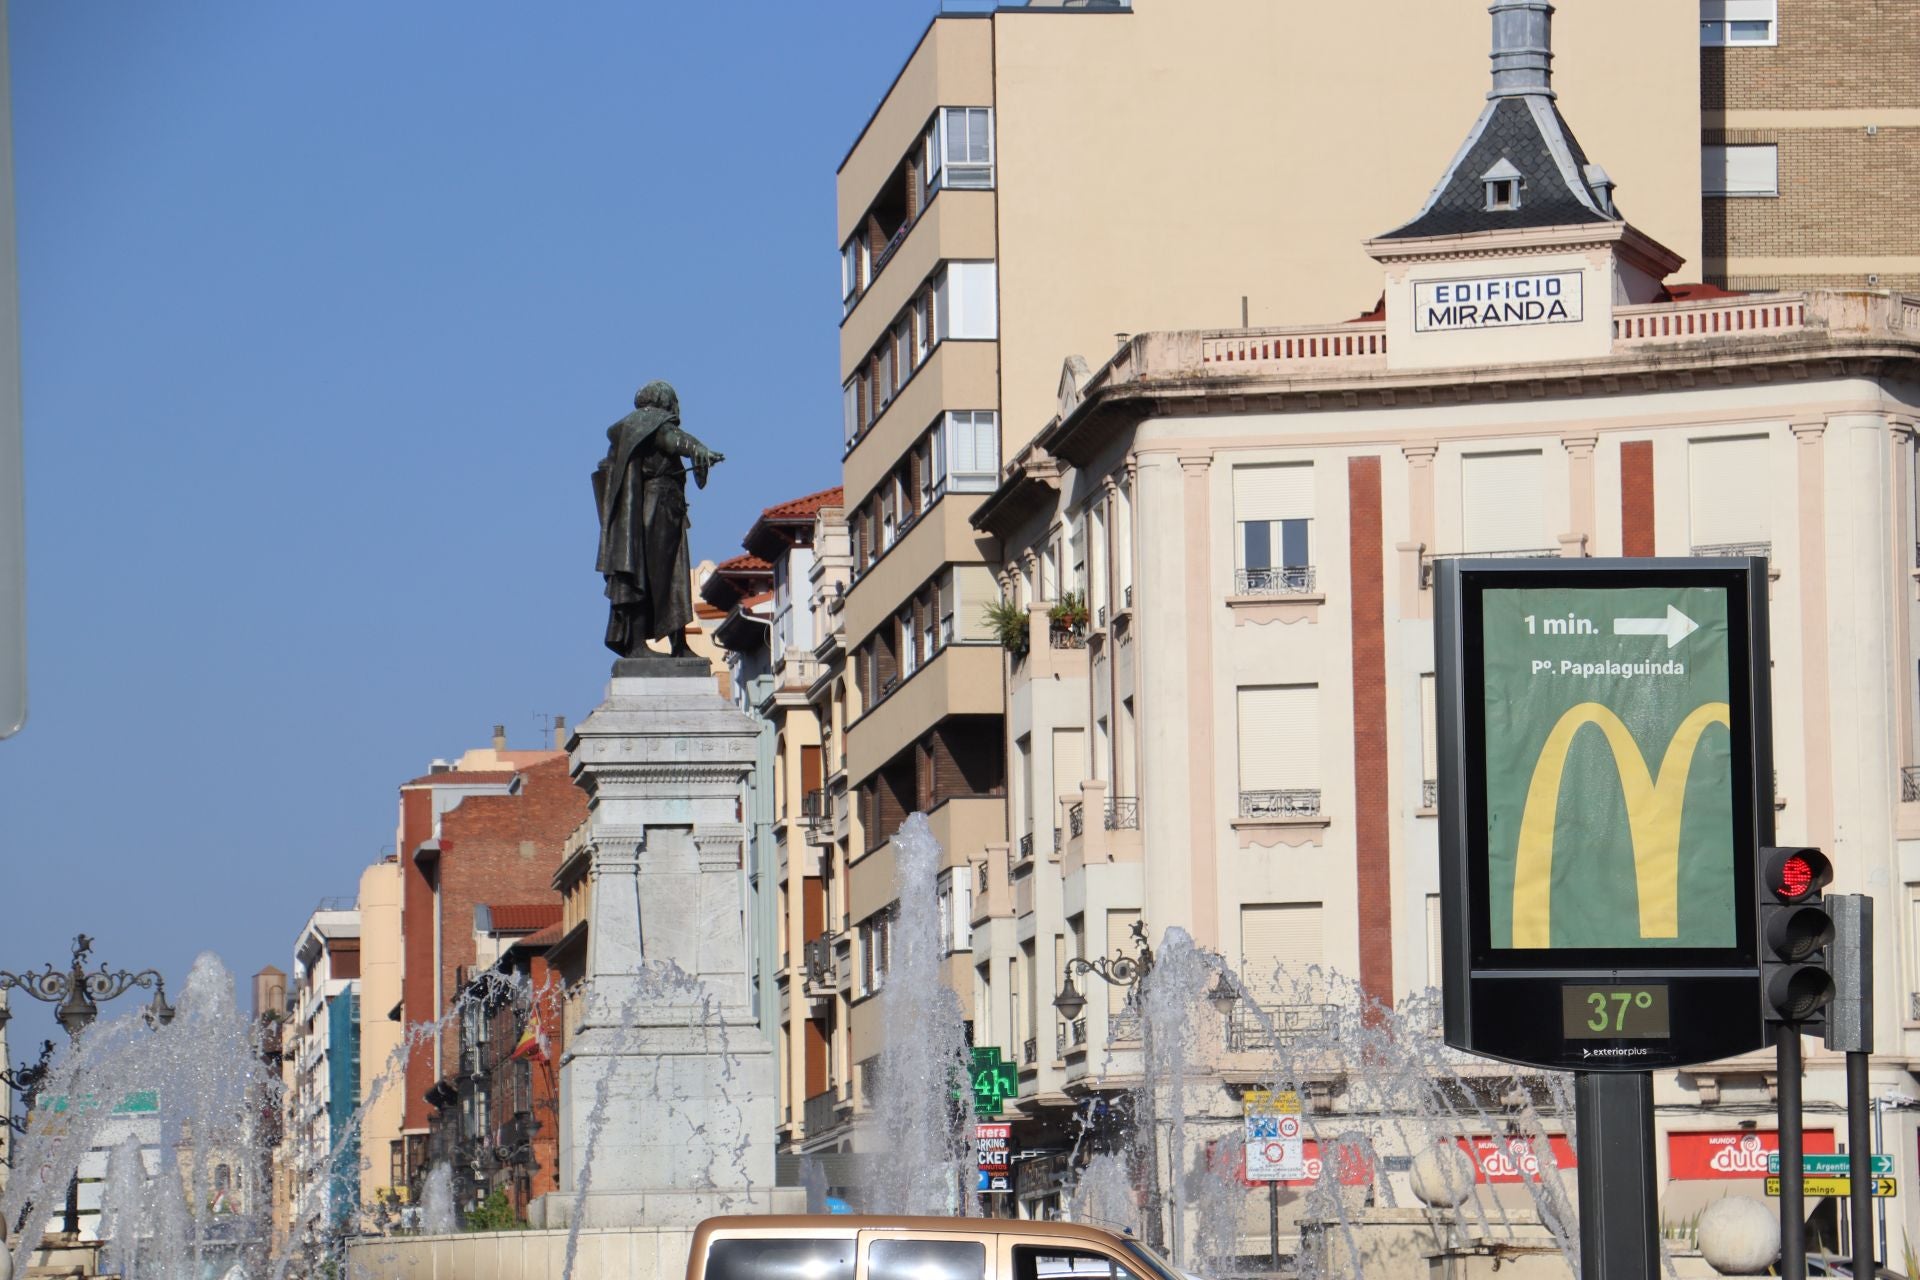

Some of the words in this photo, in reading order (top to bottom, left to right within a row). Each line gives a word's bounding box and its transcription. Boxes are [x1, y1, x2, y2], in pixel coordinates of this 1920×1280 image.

[1436, 278, 1561, 303] EDIFICIO
[1429, 299, 1568, 326] MIRANDA
[1524, 615, 1536, 635] 1
[1543, 612, 1599, 635] min.
[1560, 659, 1684, 679] Papalaguinda
[1593, 1047, 1647, 1057] exteriorplus
[966, 1069, 1011, 1096] 4h
[1709, 1137, 1736, 1145] MUNDO
[1485, 1152, 1538, 1174] dulc
[1714, 1148, 1768, 1170] dulc
[1816, 1163, 1849, 1172] Argentin
[1804, 1186, 1835, 1195] omingo
